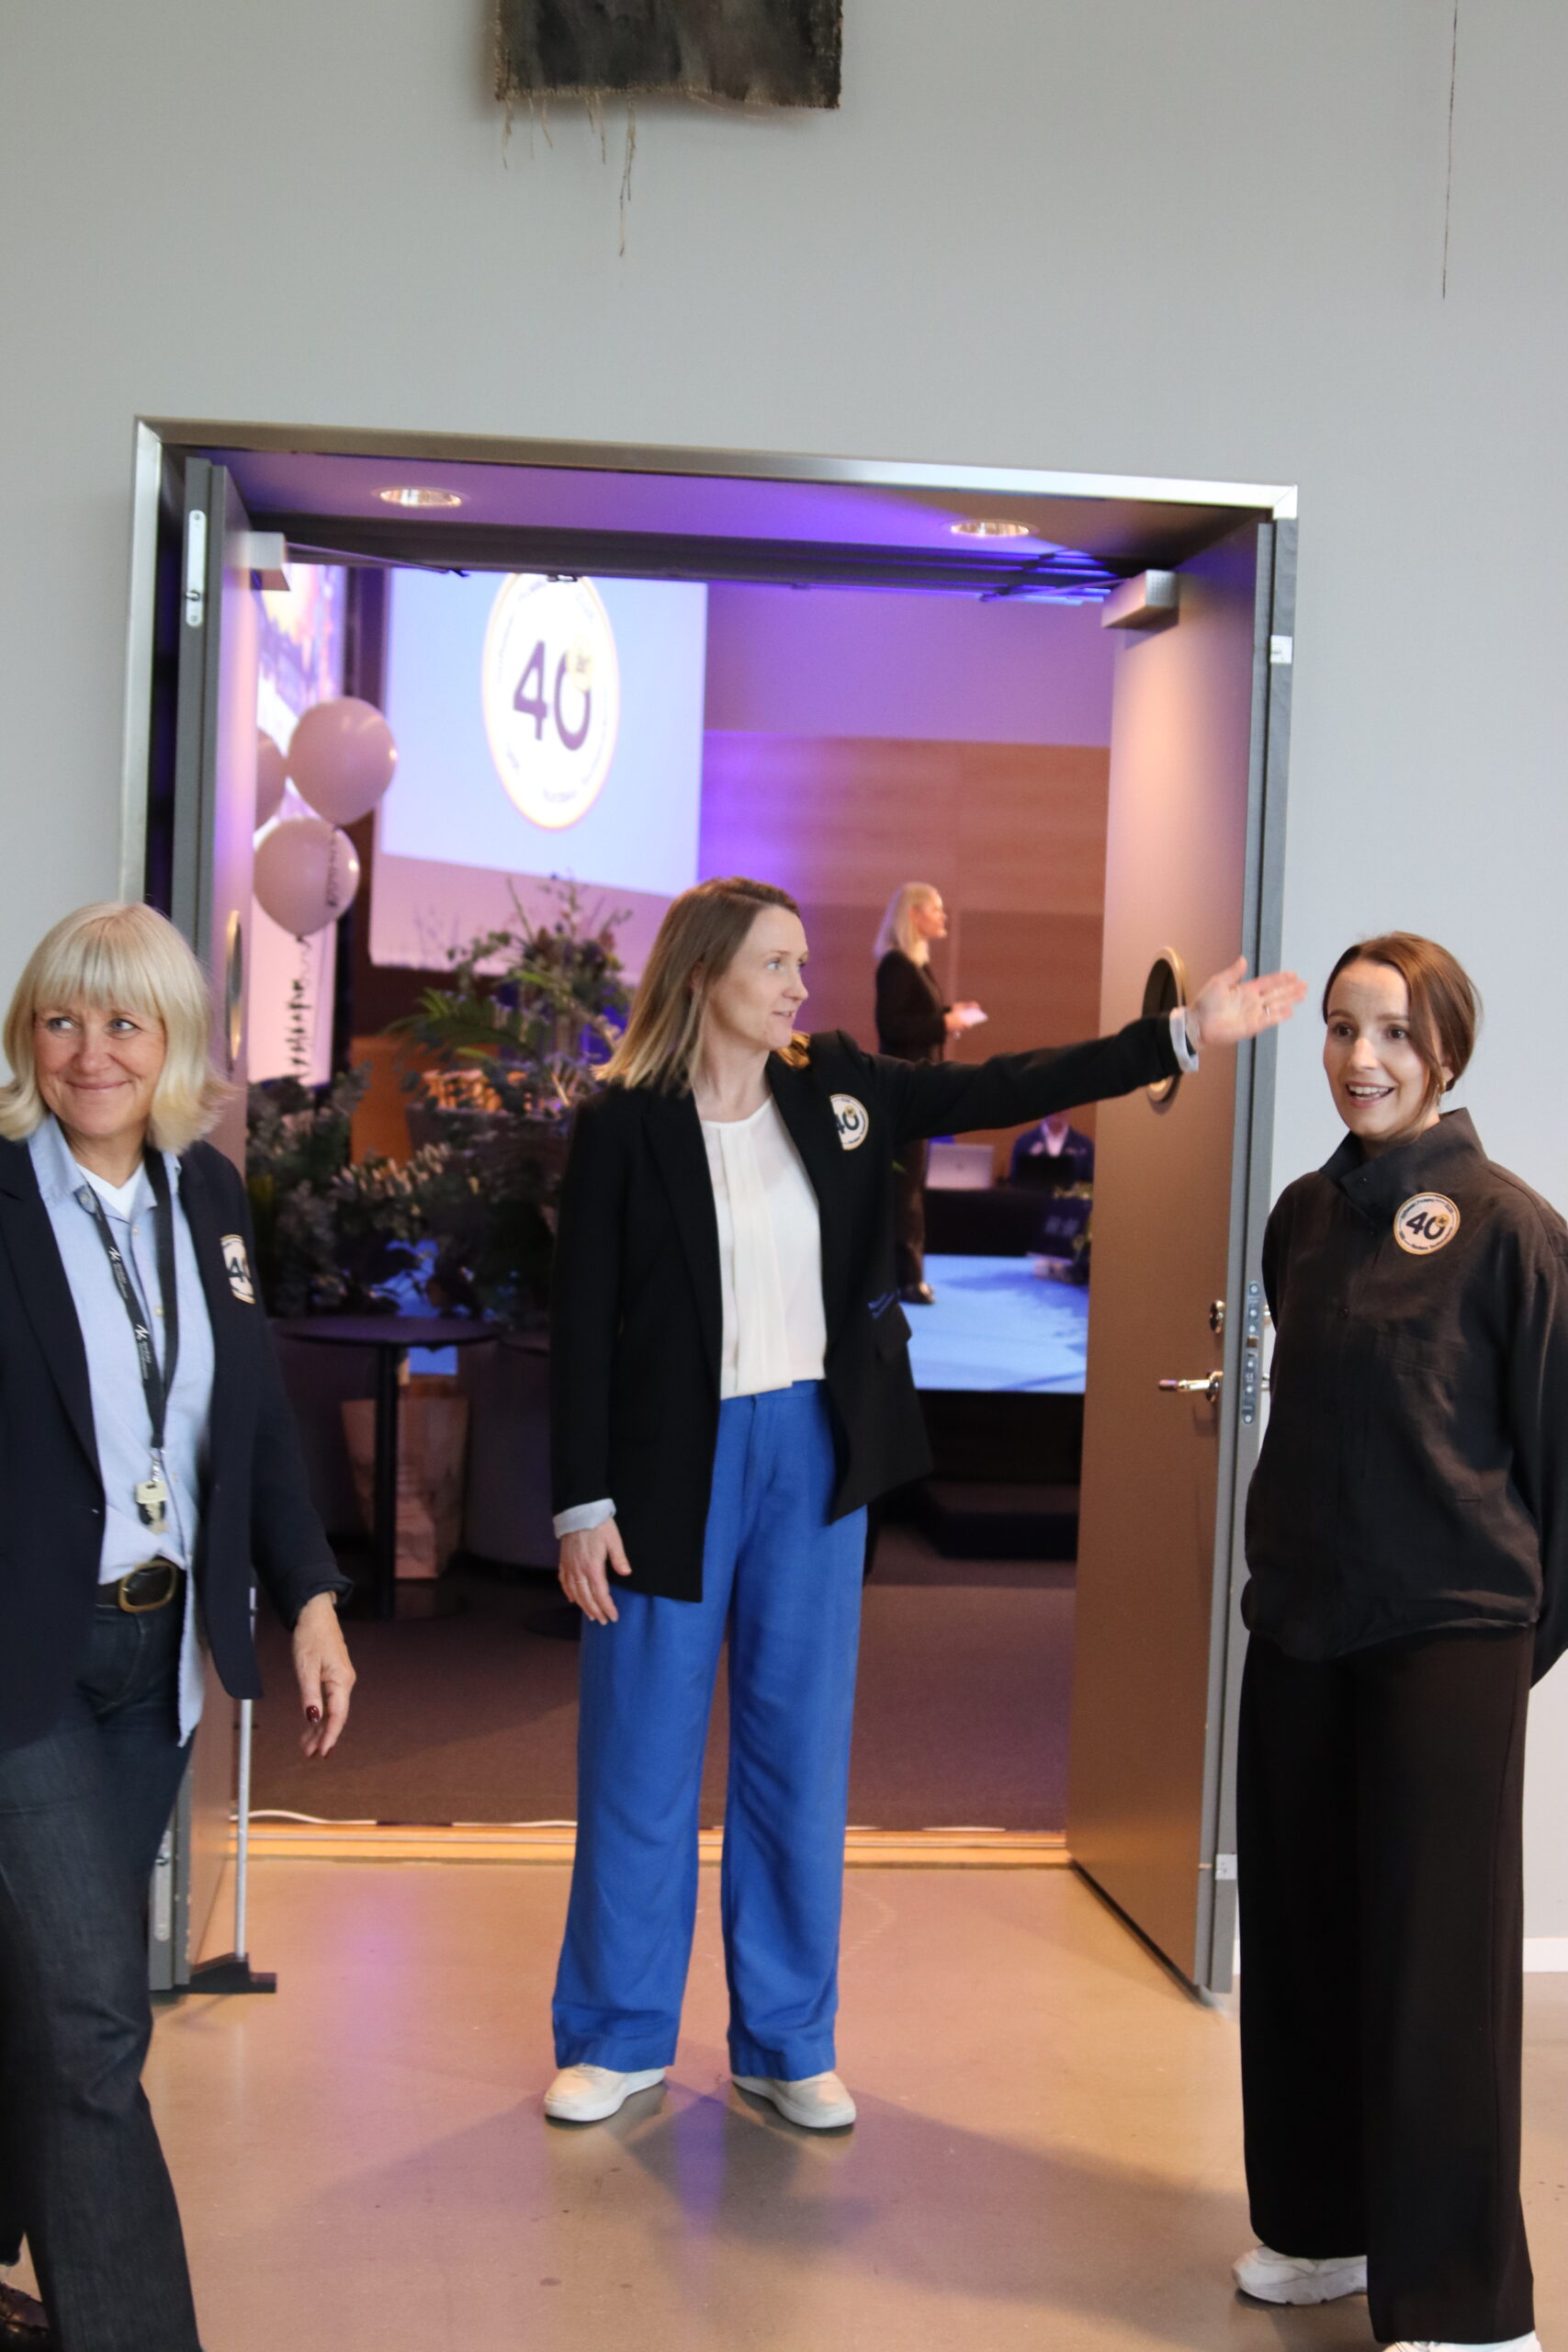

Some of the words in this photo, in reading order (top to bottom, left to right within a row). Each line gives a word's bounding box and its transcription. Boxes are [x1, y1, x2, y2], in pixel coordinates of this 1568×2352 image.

[513, 639, 592, 752] 40
[1405, 1211, 1447, 1240] 40
[227, 1257, 250, 1283] 4
